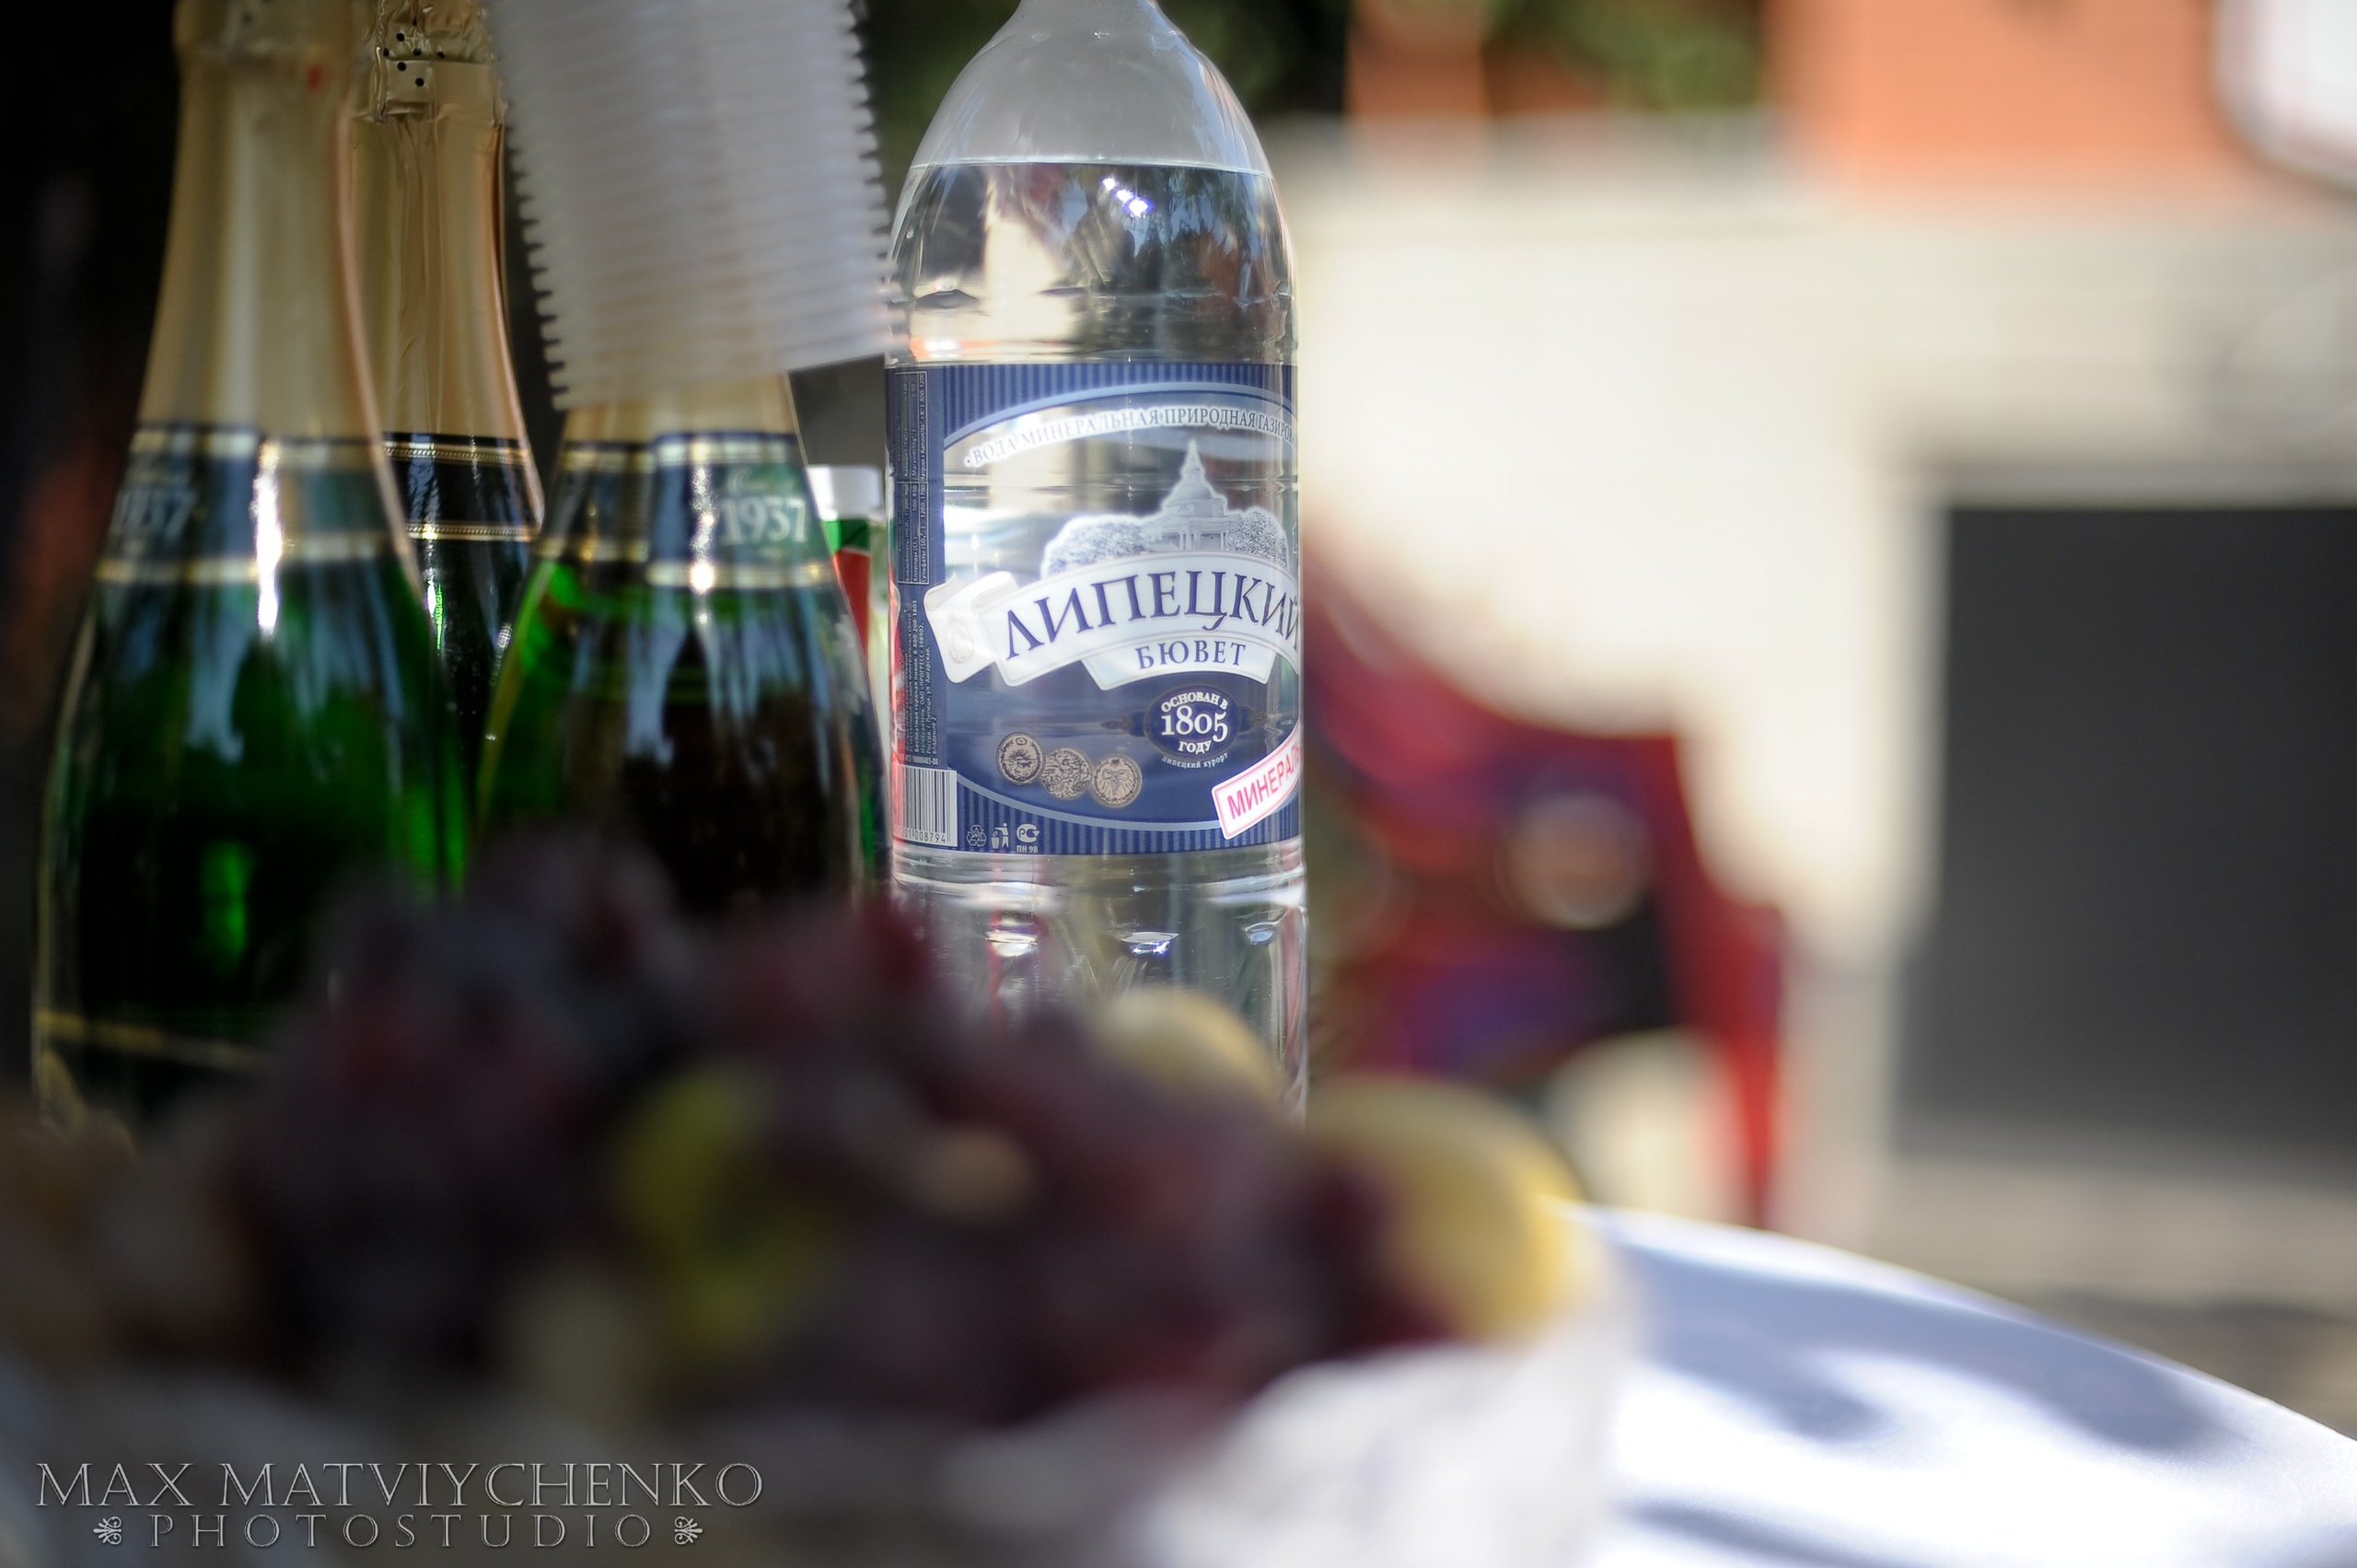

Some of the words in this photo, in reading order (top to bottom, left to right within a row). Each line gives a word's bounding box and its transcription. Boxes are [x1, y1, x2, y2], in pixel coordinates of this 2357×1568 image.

[972, 437, 1016, 464] ВОДА
[1021, 410, 1159, 446] МИНЕРАЛЬНАЯ
[1165, 408, 1256, 428] ПРИРОДНАЯ
[1006, 570, 1299, 660] ЛИПЕЦКИЙ
[1134, 640, 1247, 670] БЮВЕТ
[1161, 691, 1221, 713] ОСНОВАН
[1220, 700, 1228, 710] В
[1161, 704, 1228, 742] 1805
[1161, 755, 1202, 769] липецкий
[1203, 752, 1228, 768] курорт
[1178, 740, 1212, 754] ГОДУ
